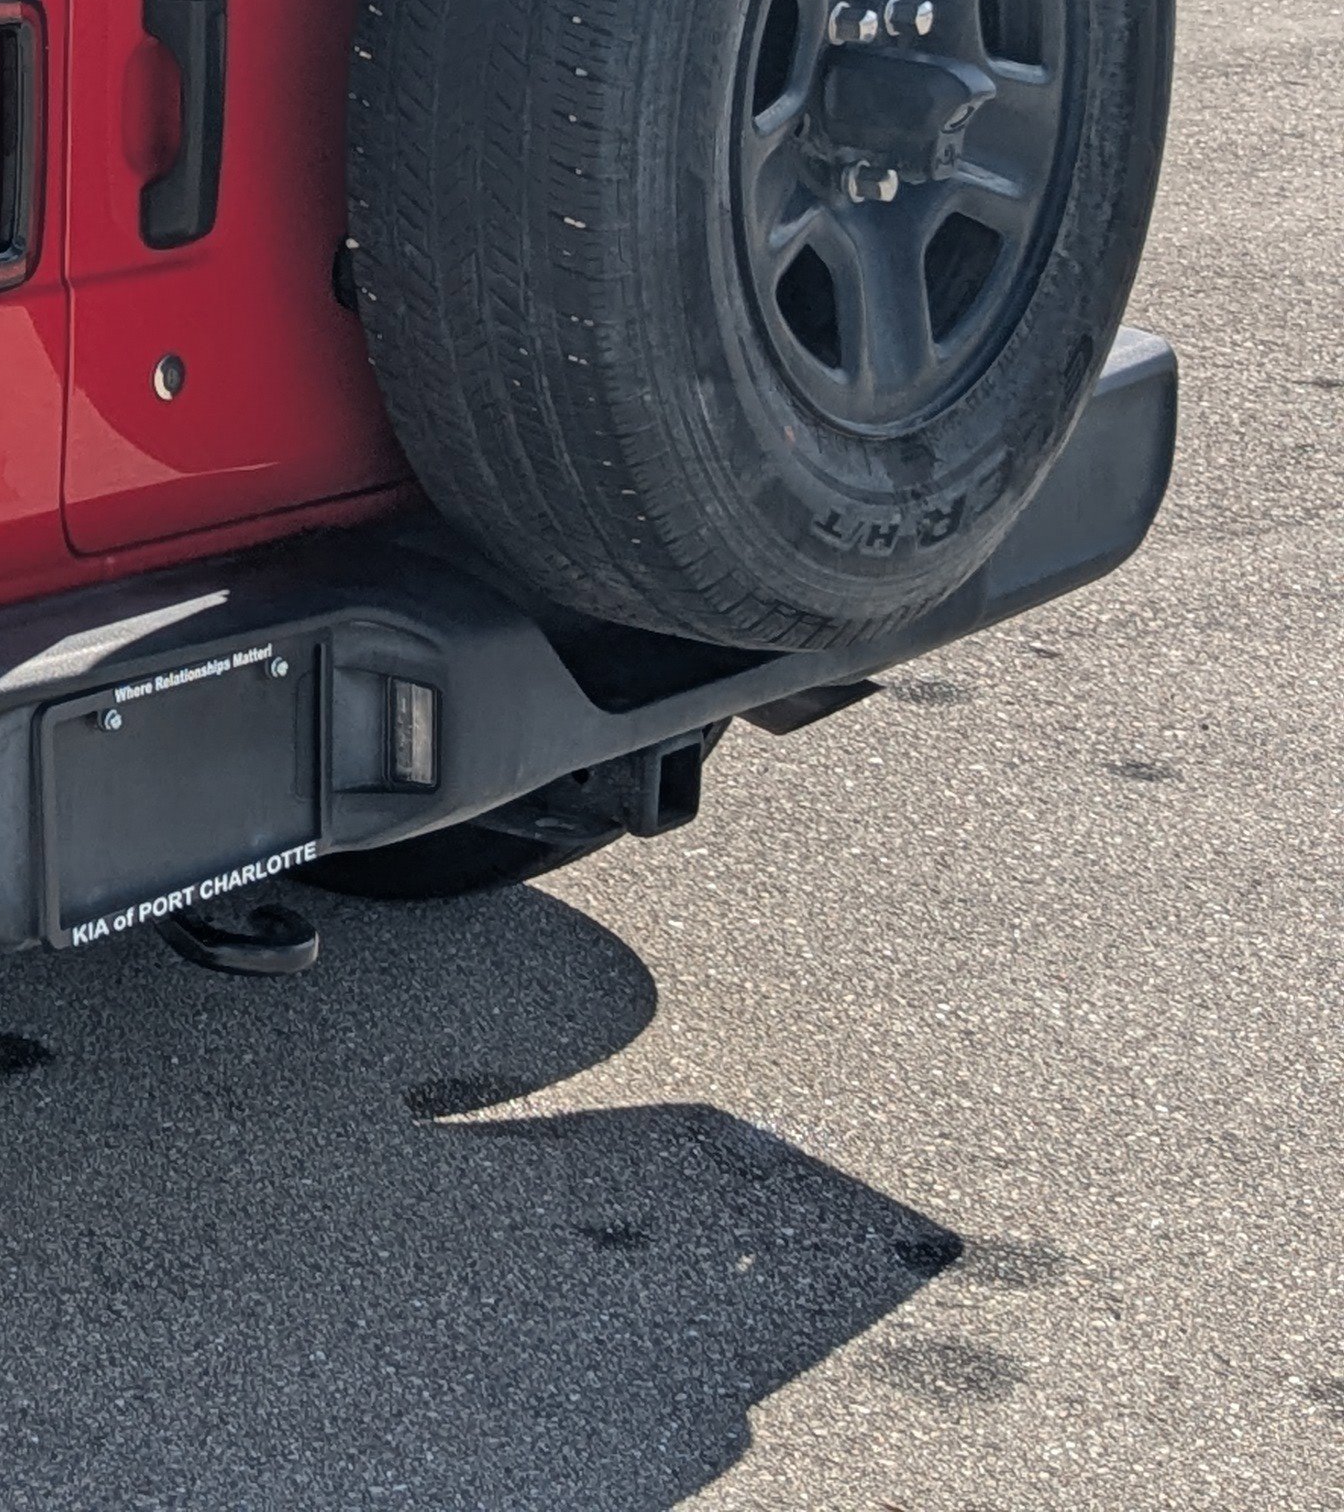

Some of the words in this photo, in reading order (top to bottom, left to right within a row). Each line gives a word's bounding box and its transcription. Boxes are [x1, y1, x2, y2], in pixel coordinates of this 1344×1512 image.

[114, 681, 153, 703] Where
[155, 656, 231, 692] Relationships
[233, 642, 273, 668] Matter!
[72, 918, 110, 947] KIA
[113, 906, 134, 931] of
[139, 885, 195, 922] PORT
[199, 840, 317, 900] CHARLOTTE
